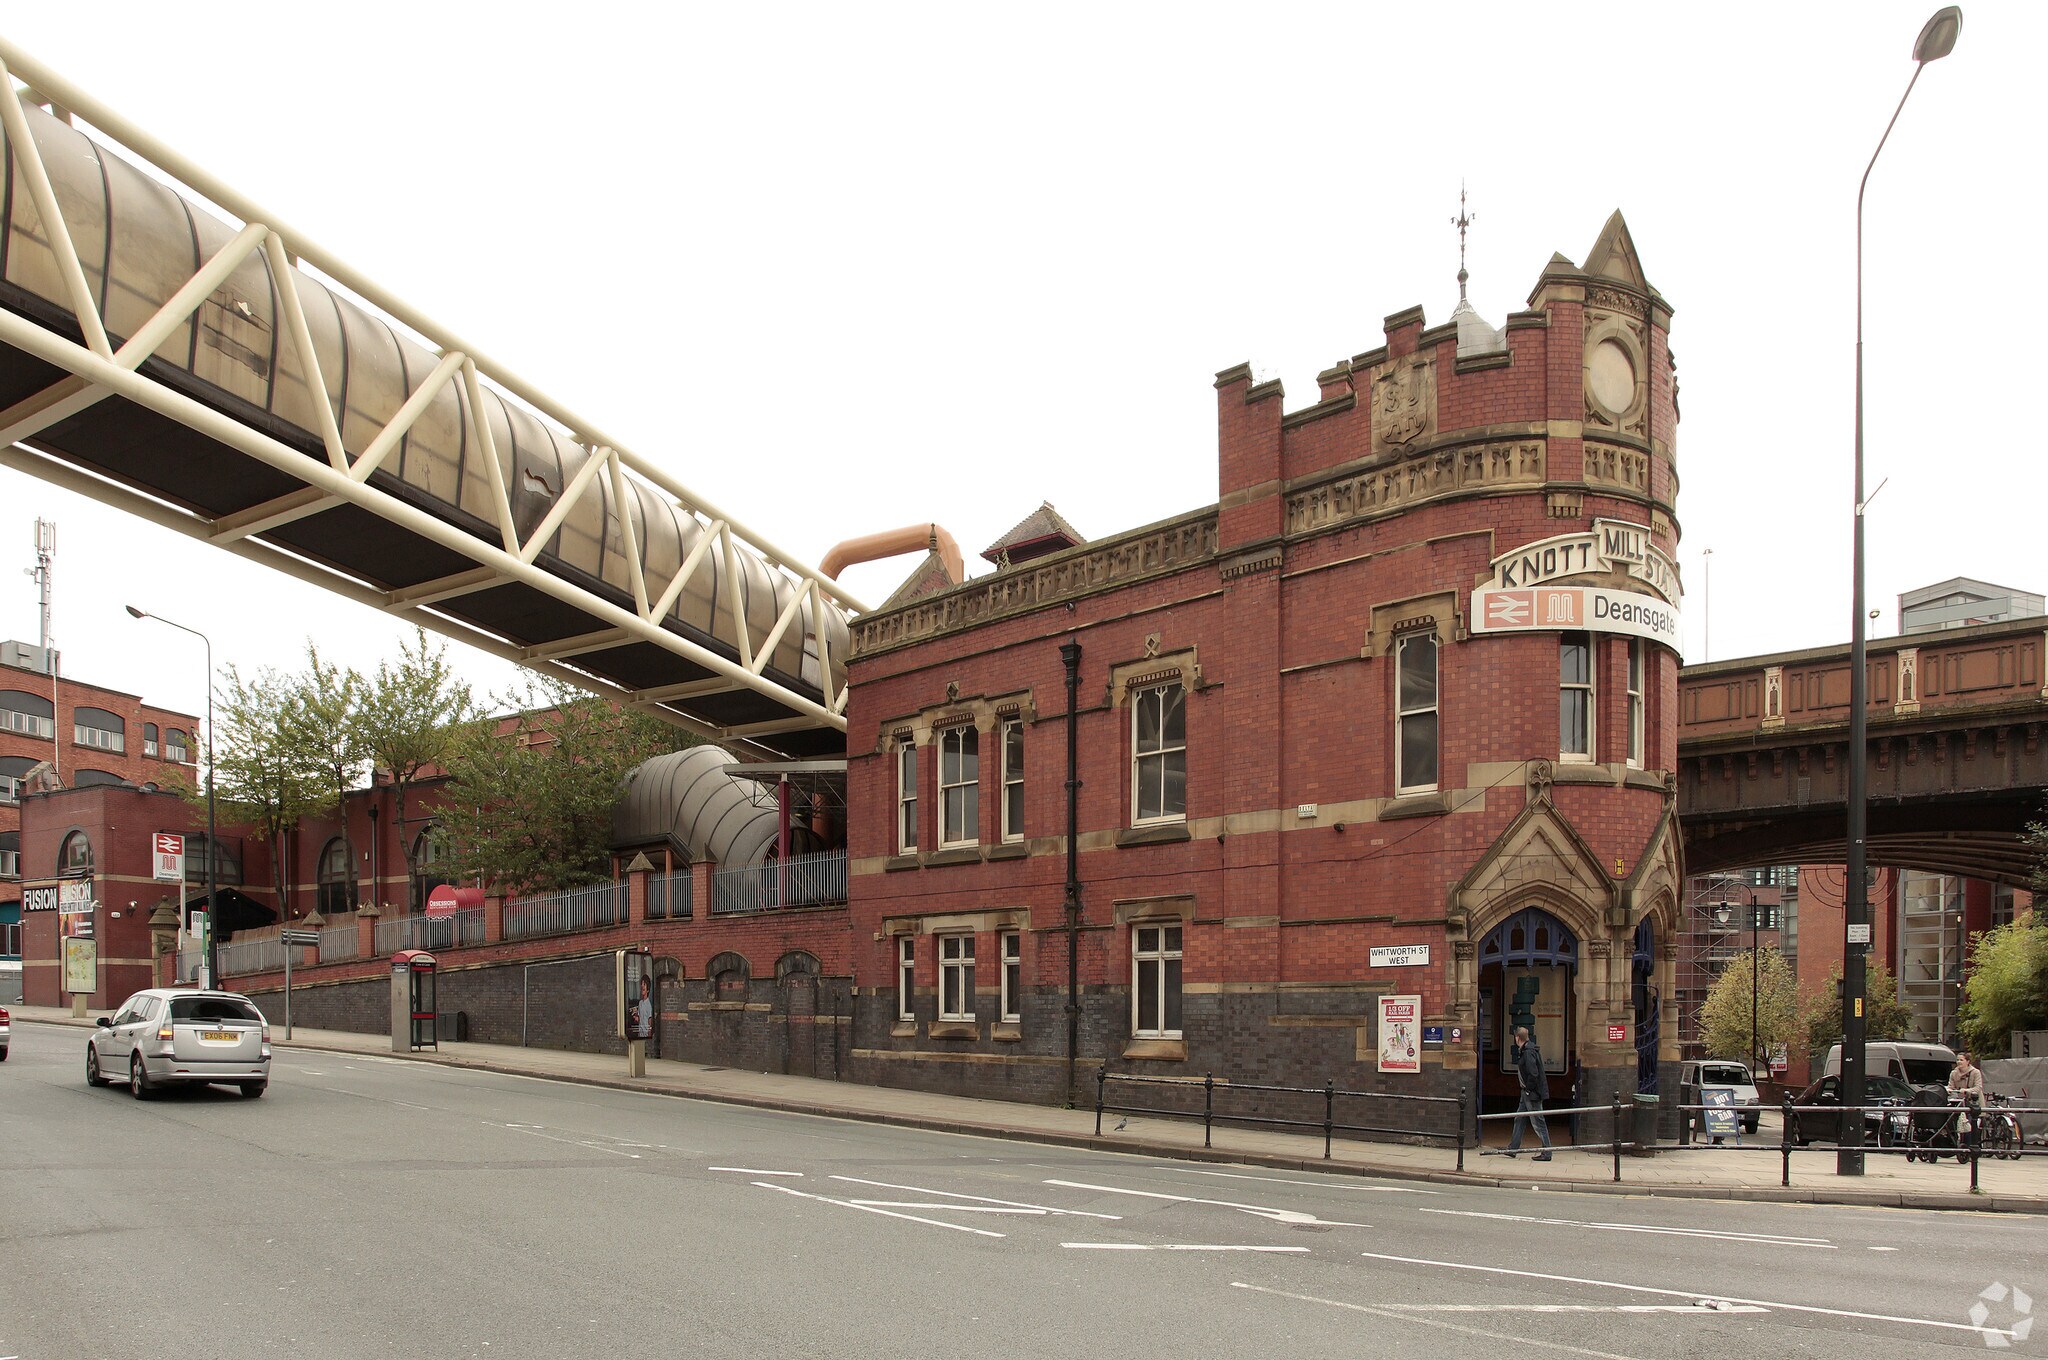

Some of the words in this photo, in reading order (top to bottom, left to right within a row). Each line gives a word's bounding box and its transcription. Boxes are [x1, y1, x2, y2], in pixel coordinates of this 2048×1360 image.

[1502, 542, 1592, 588] KNOTT
[1604, 528, 1644, 560] MILL
[1594, 594, 1675, 636] Deansgate
[24, 888, 57, 911] FUSION
[1371, 946, 1416, 956] WHITWORTH
[1419, 946, 1428, 954] ST
[1389, 956, 1409, 965] WEST
[1714, 1092, 1729, 1104] HOT
[1717, 1110, 1735, 1121] BAR
